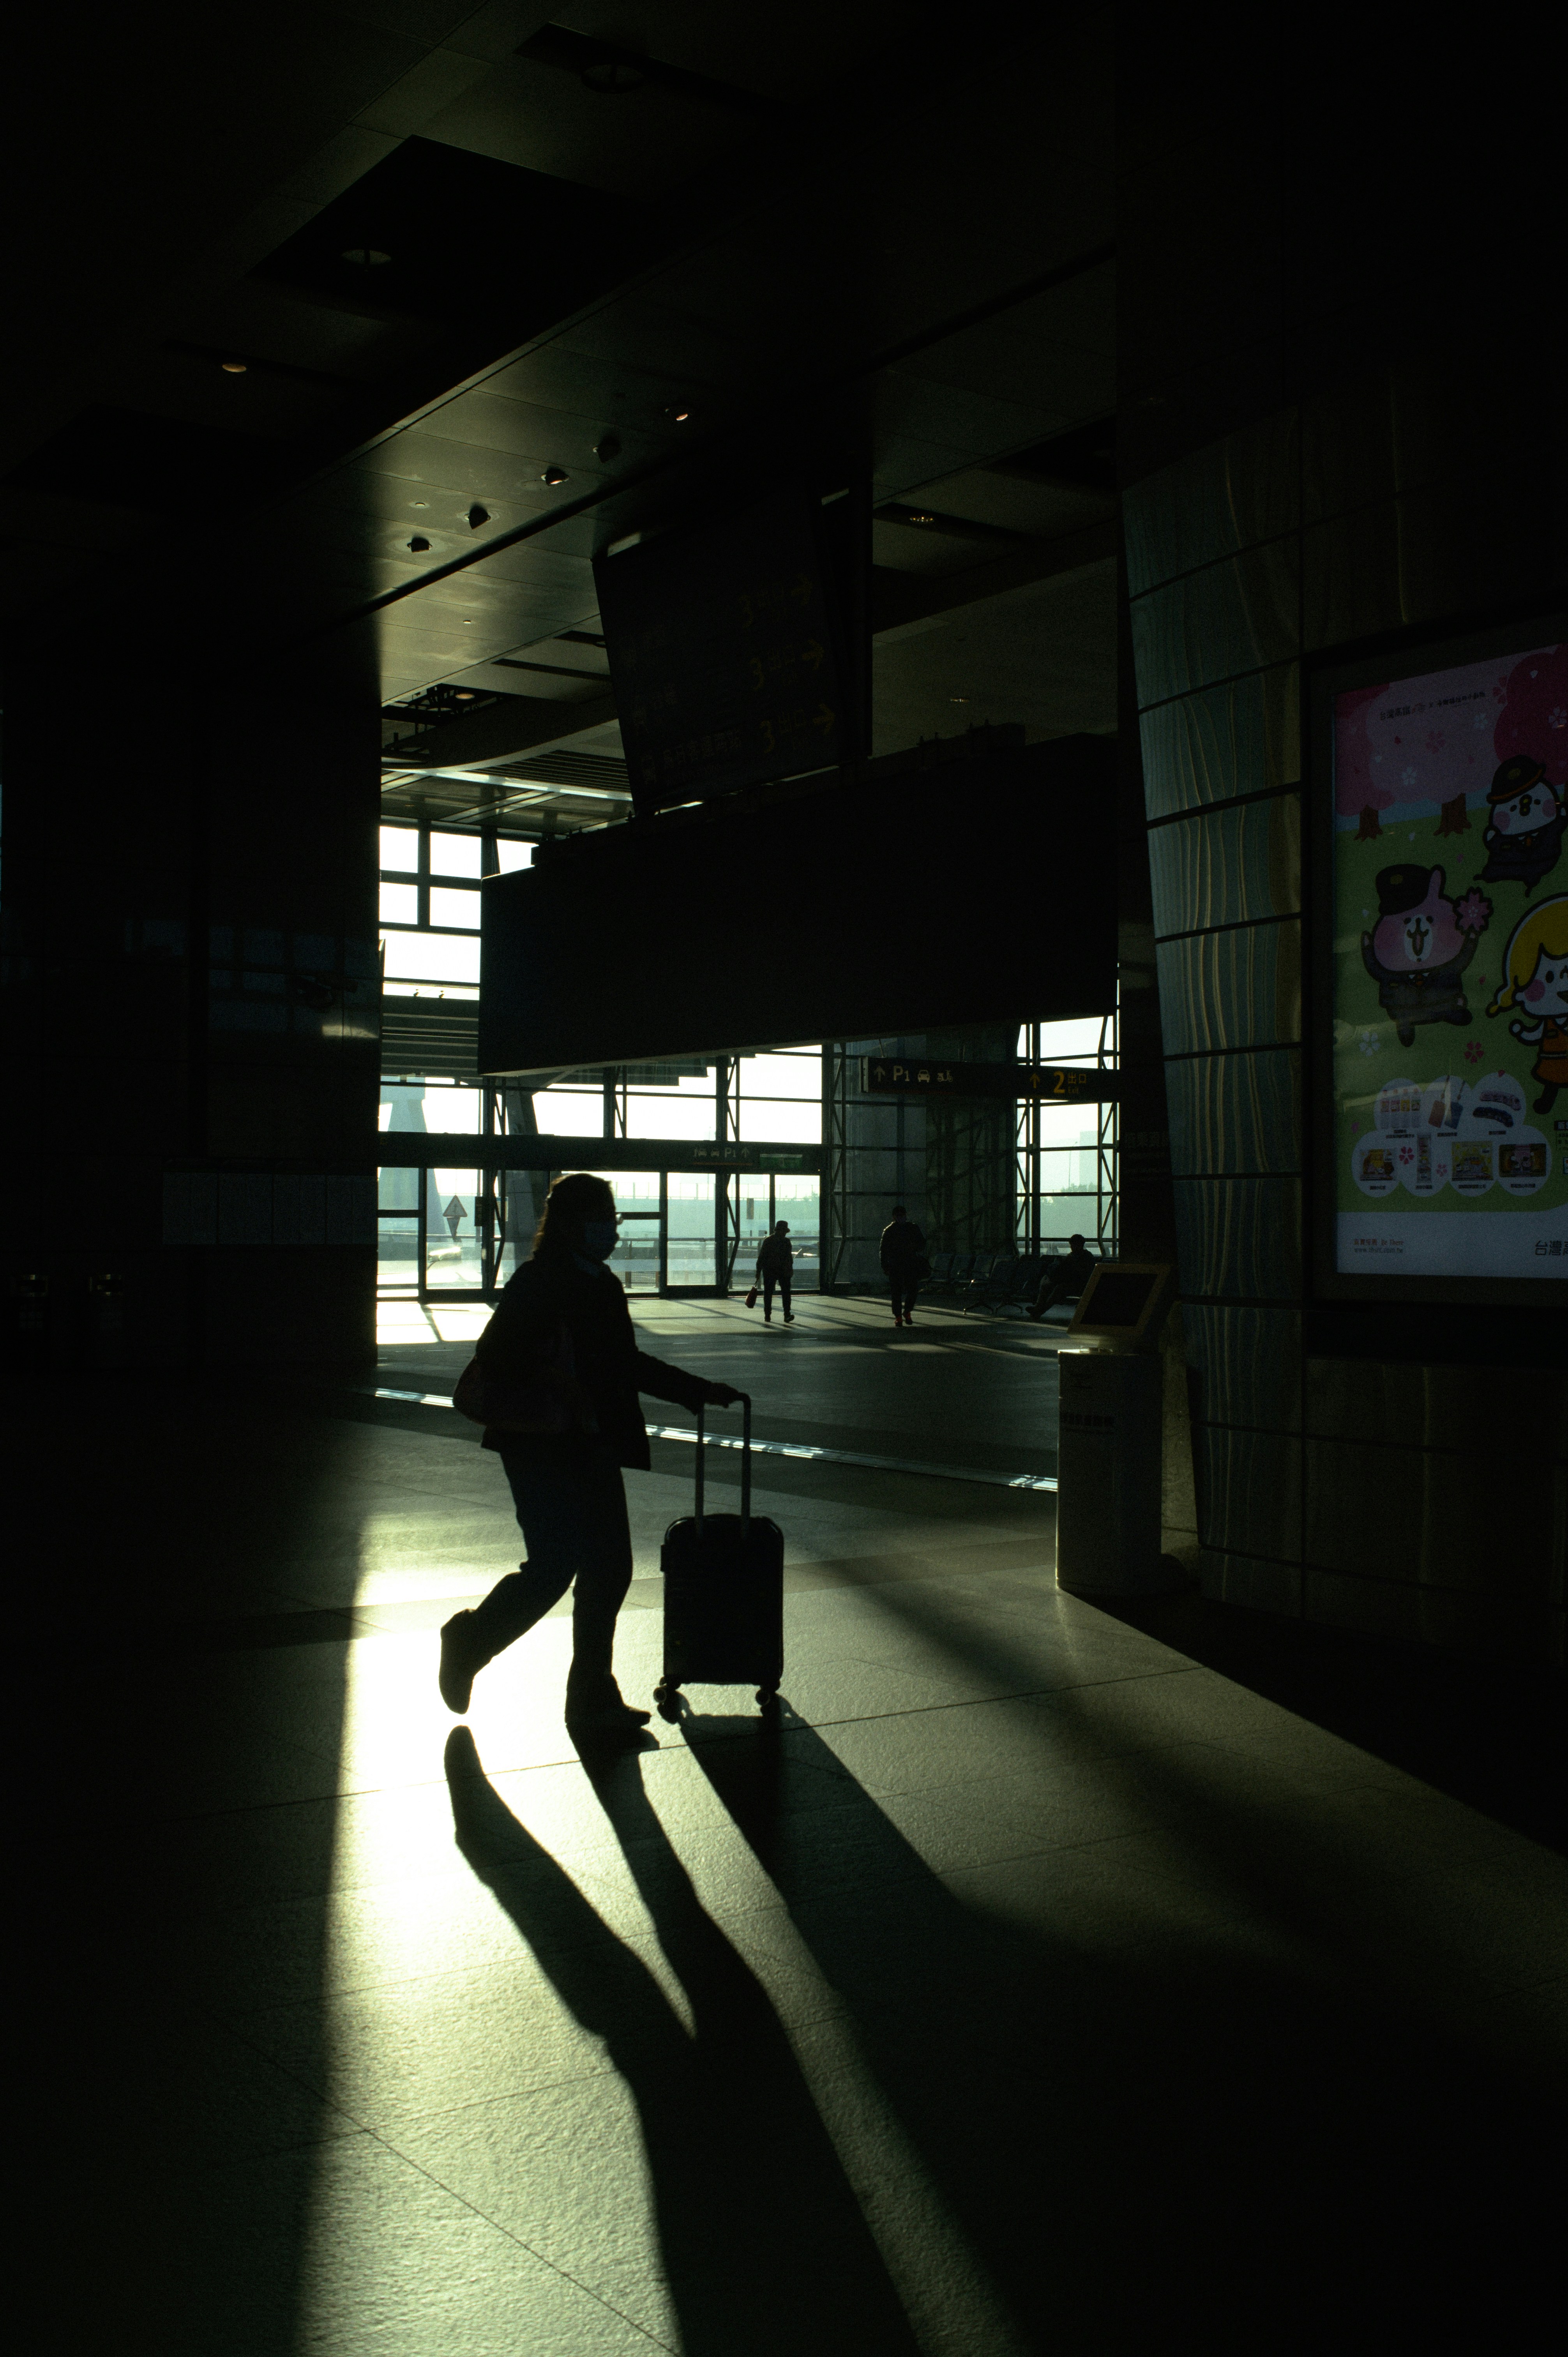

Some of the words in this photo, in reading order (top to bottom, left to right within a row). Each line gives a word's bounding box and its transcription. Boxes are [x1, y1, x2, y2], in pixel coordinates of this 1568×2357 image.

[738, 594, 754, 629] 3
[749, 657, 765, 692] 3
[768, 644, 796, 671] 出口
[759, 719, 775, 753] 3
[777, 709, 807, 735] 出口
[893, 1065, 910, 1082] P1
[1053, 1071, 1066, 1094] 2
[1068, 1072, 1087, 1084] 出口
[724, 1147, 736, 1158] P1
